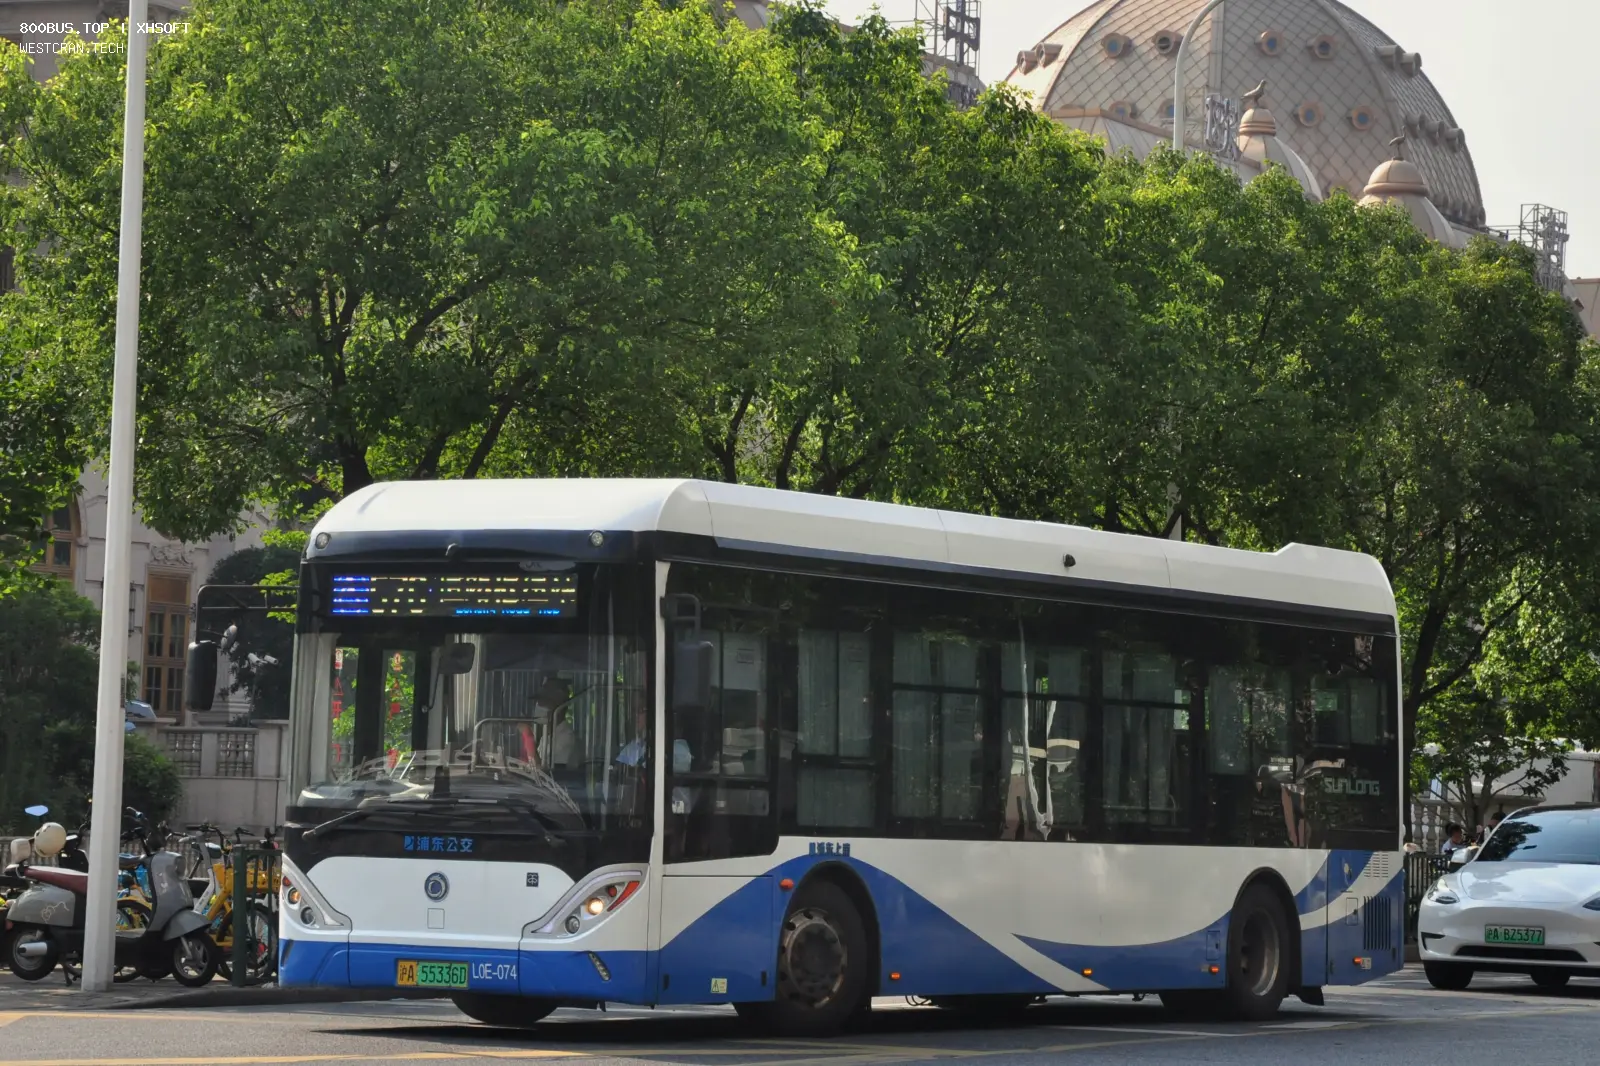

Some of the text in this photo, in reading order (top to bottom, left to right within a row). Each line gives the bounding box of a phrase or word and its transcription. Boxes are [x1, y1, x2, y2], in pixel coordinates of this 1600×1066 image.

[416, 836, 473, 853] 浦东公交
[1503, 928, 1542, 942] BZ5377
[420, 965, 467, 984] 55336D
